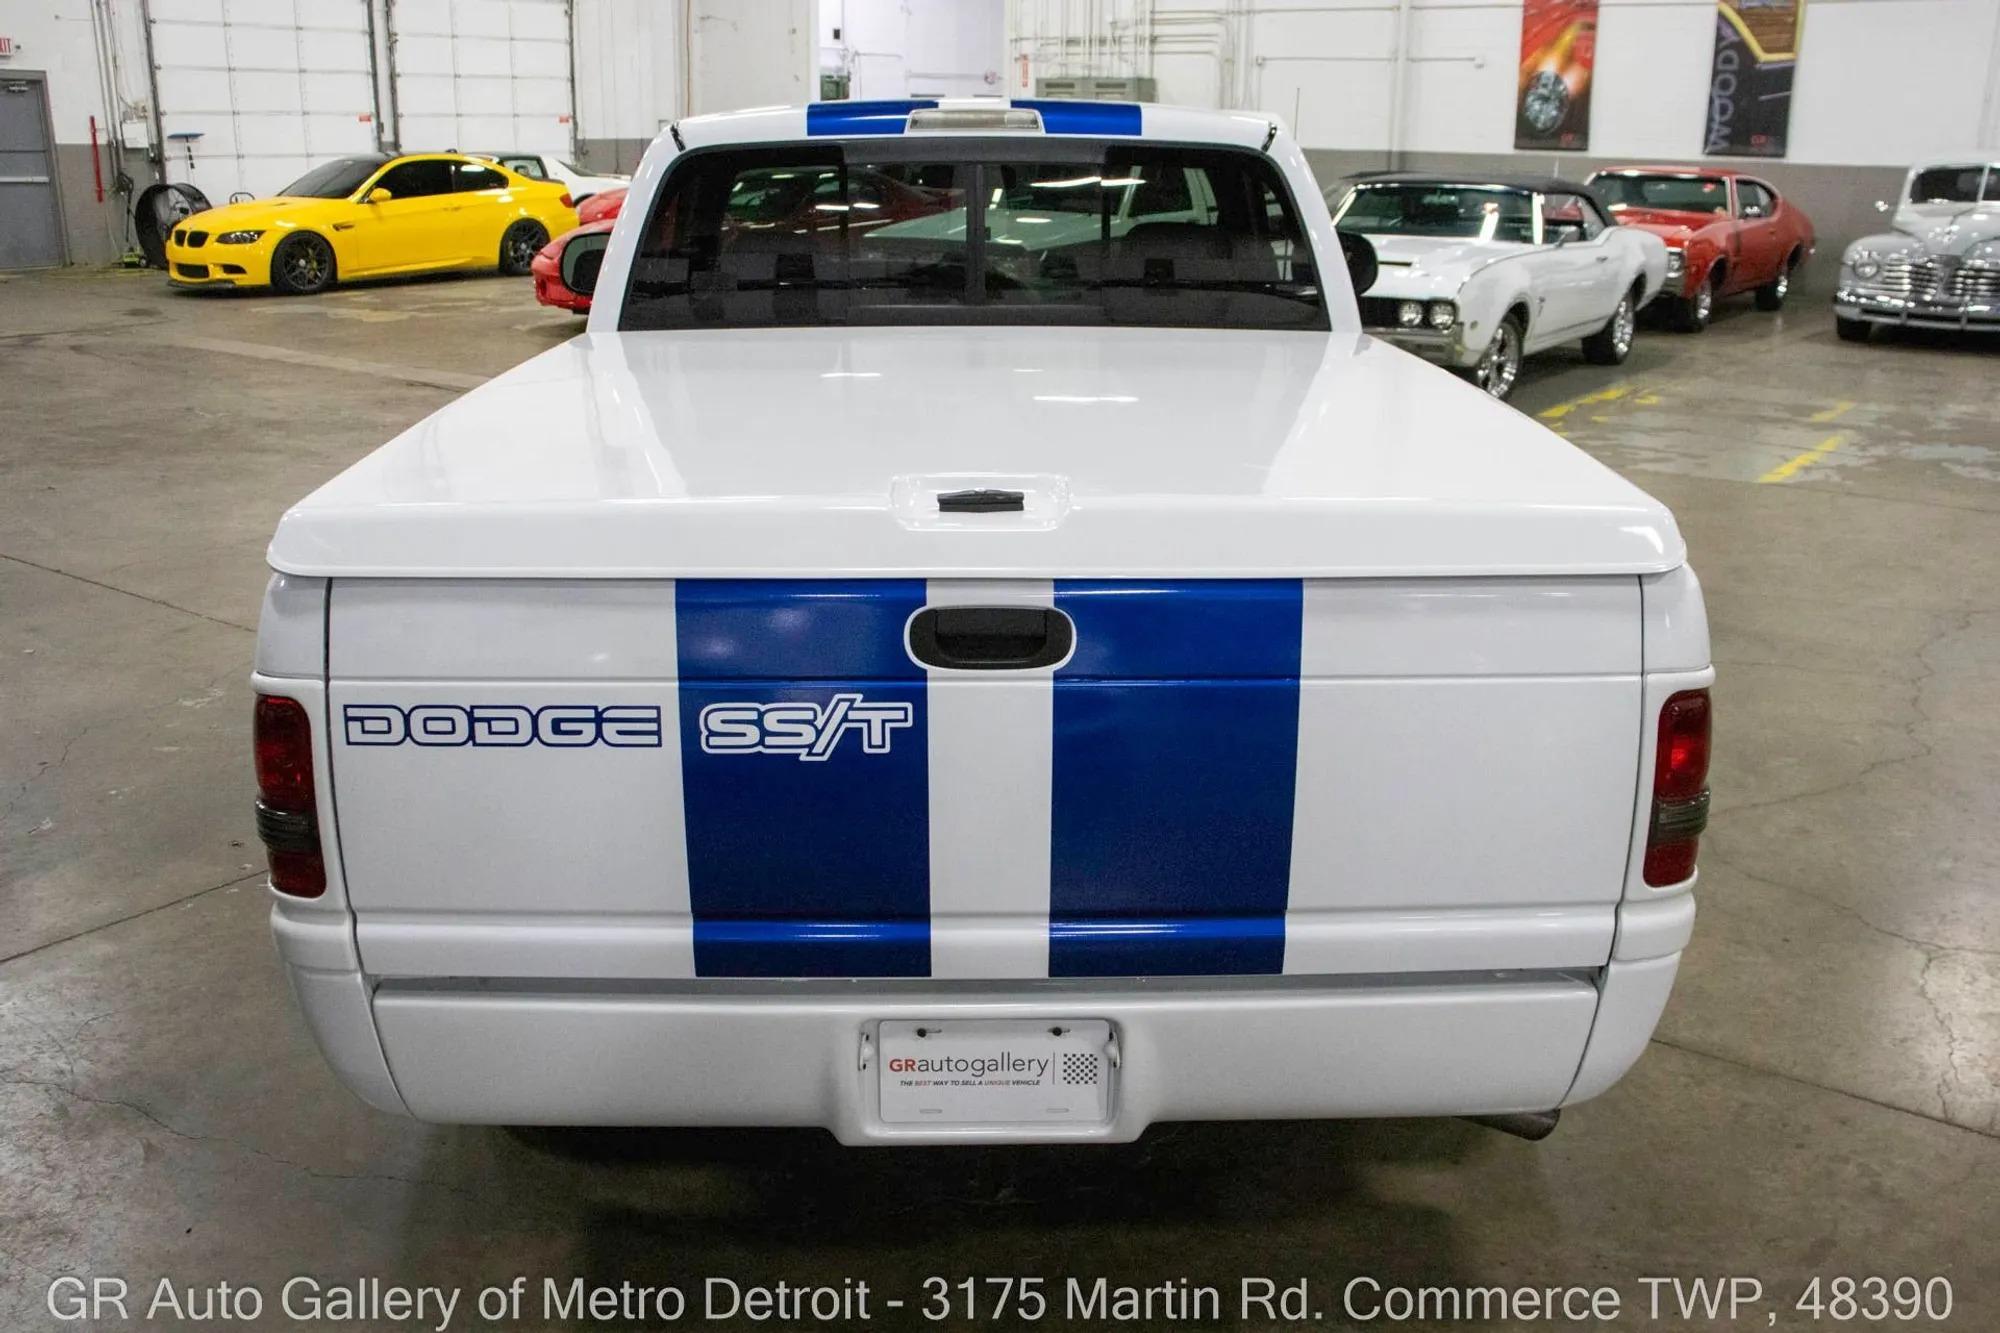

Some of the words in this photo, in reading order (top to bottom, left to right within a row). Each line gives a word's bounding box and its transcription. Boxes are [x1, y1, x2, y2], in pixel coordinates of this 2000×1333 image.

[1704, 15, 1741, 152] WOODY
[344, 704, 662, 748] DODGE
[700, 693, 913, 761] SS/T
[900, 1079, 913, 1087] THE
[914, 1079, 932, 1087] BEST
[933, 1079, 949, 1087] WAY
[950, 1079, 960, 1087] TO
[961, 1079, 977, 1087] SELL
[978, 1079, 984, 1087] A
[984, 1079, 1010, 1087] UNIQUE
[1011, 1079, 1041, 1087] VEHICLE
